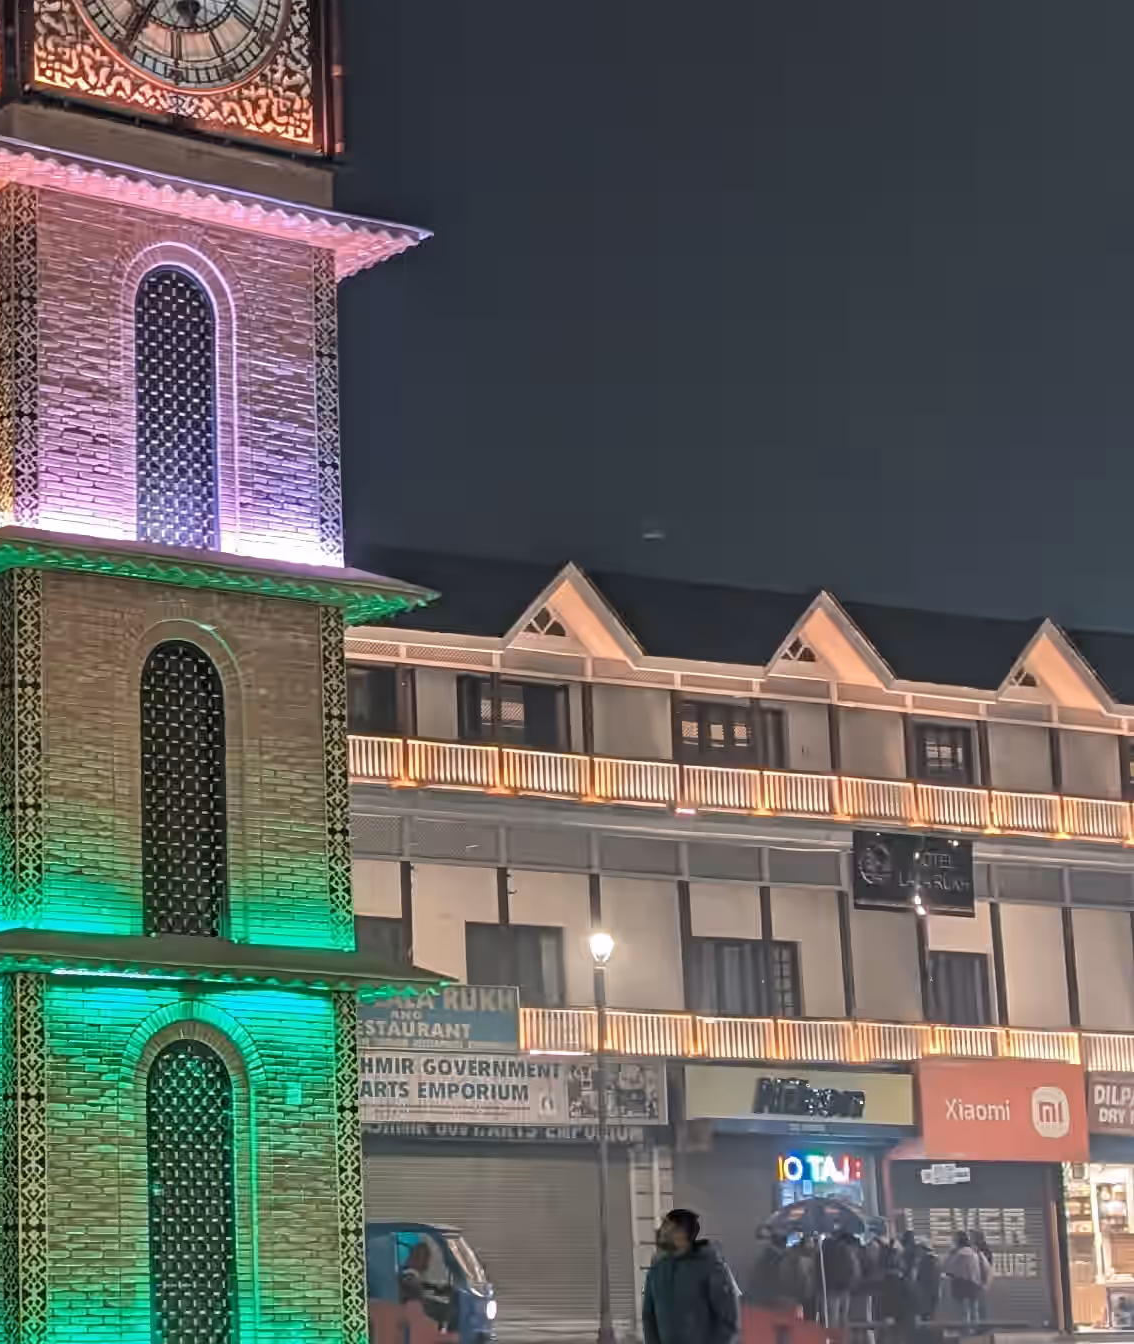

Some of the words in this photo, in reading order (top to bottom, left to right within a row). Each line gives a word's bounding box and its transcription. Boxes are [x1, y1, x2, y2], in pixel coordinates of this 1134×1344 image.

[356, 1020, 471, 1038] ESTAURANT
[360, 1057, 415, 1075] HMIR
[423, 1058, 560, 1079] GOVERNMENT
[360, 1081, 409, 1099] ARTS
[417, 1082, 529, 1101] EMPORIUM
[946, 1099, 1011, 1121] Xiaomi
[1099, 1108, 1126, 1124] DRY
